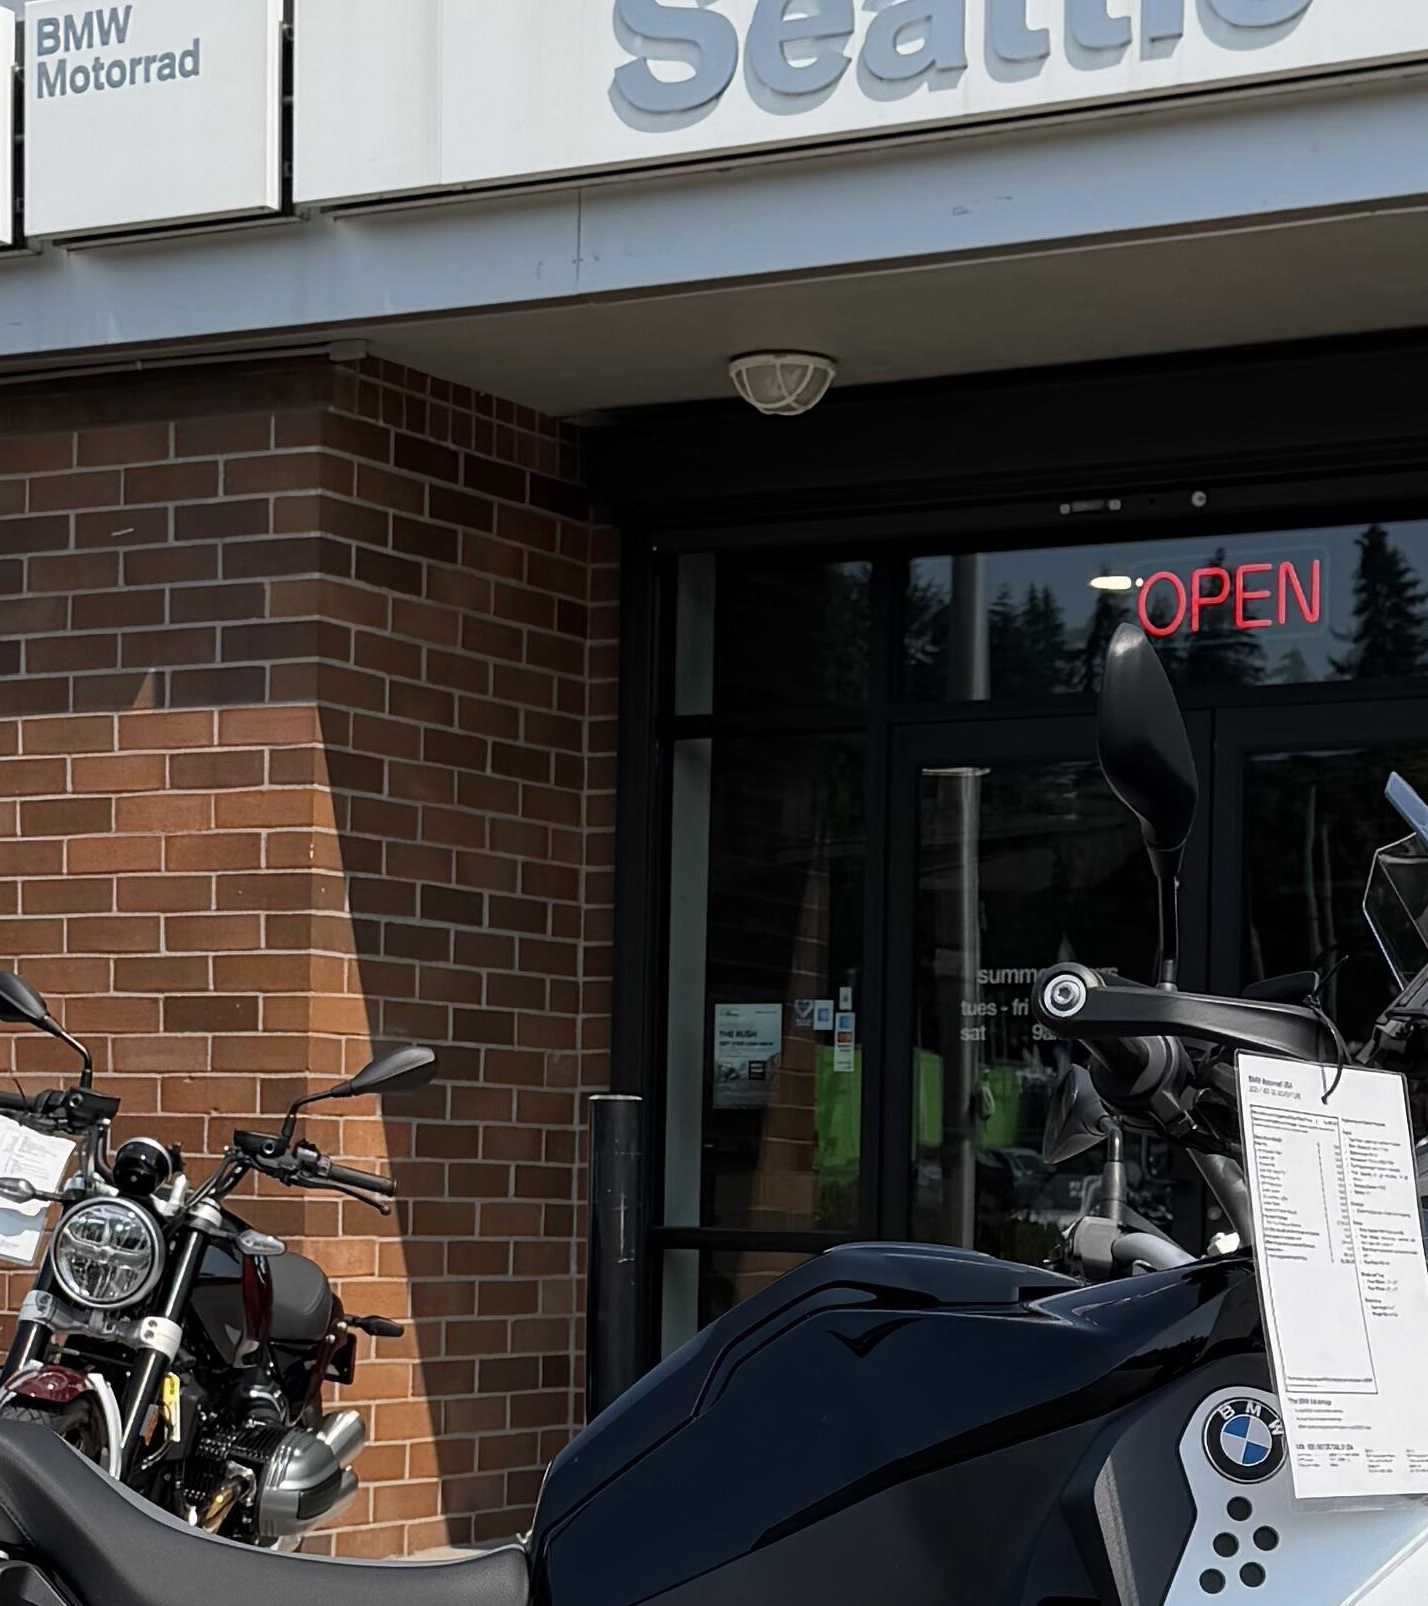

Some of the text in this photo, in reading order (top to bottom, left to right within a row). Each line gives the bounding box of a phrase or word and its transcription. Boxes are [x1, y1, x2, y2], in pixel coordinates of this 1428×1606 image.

[36, 5, 132, 57] BMW
[36, 39, 200, 99] Motorrad
[1137, 557, 1322, 638] OPEN
[960, 1001, 997, 1017] tues
[1012, 998, 1029, 1016] fri
[960, 1023, 1058, 1041] sat 9a
[1217, 1400, 1285, 1437] BMW
